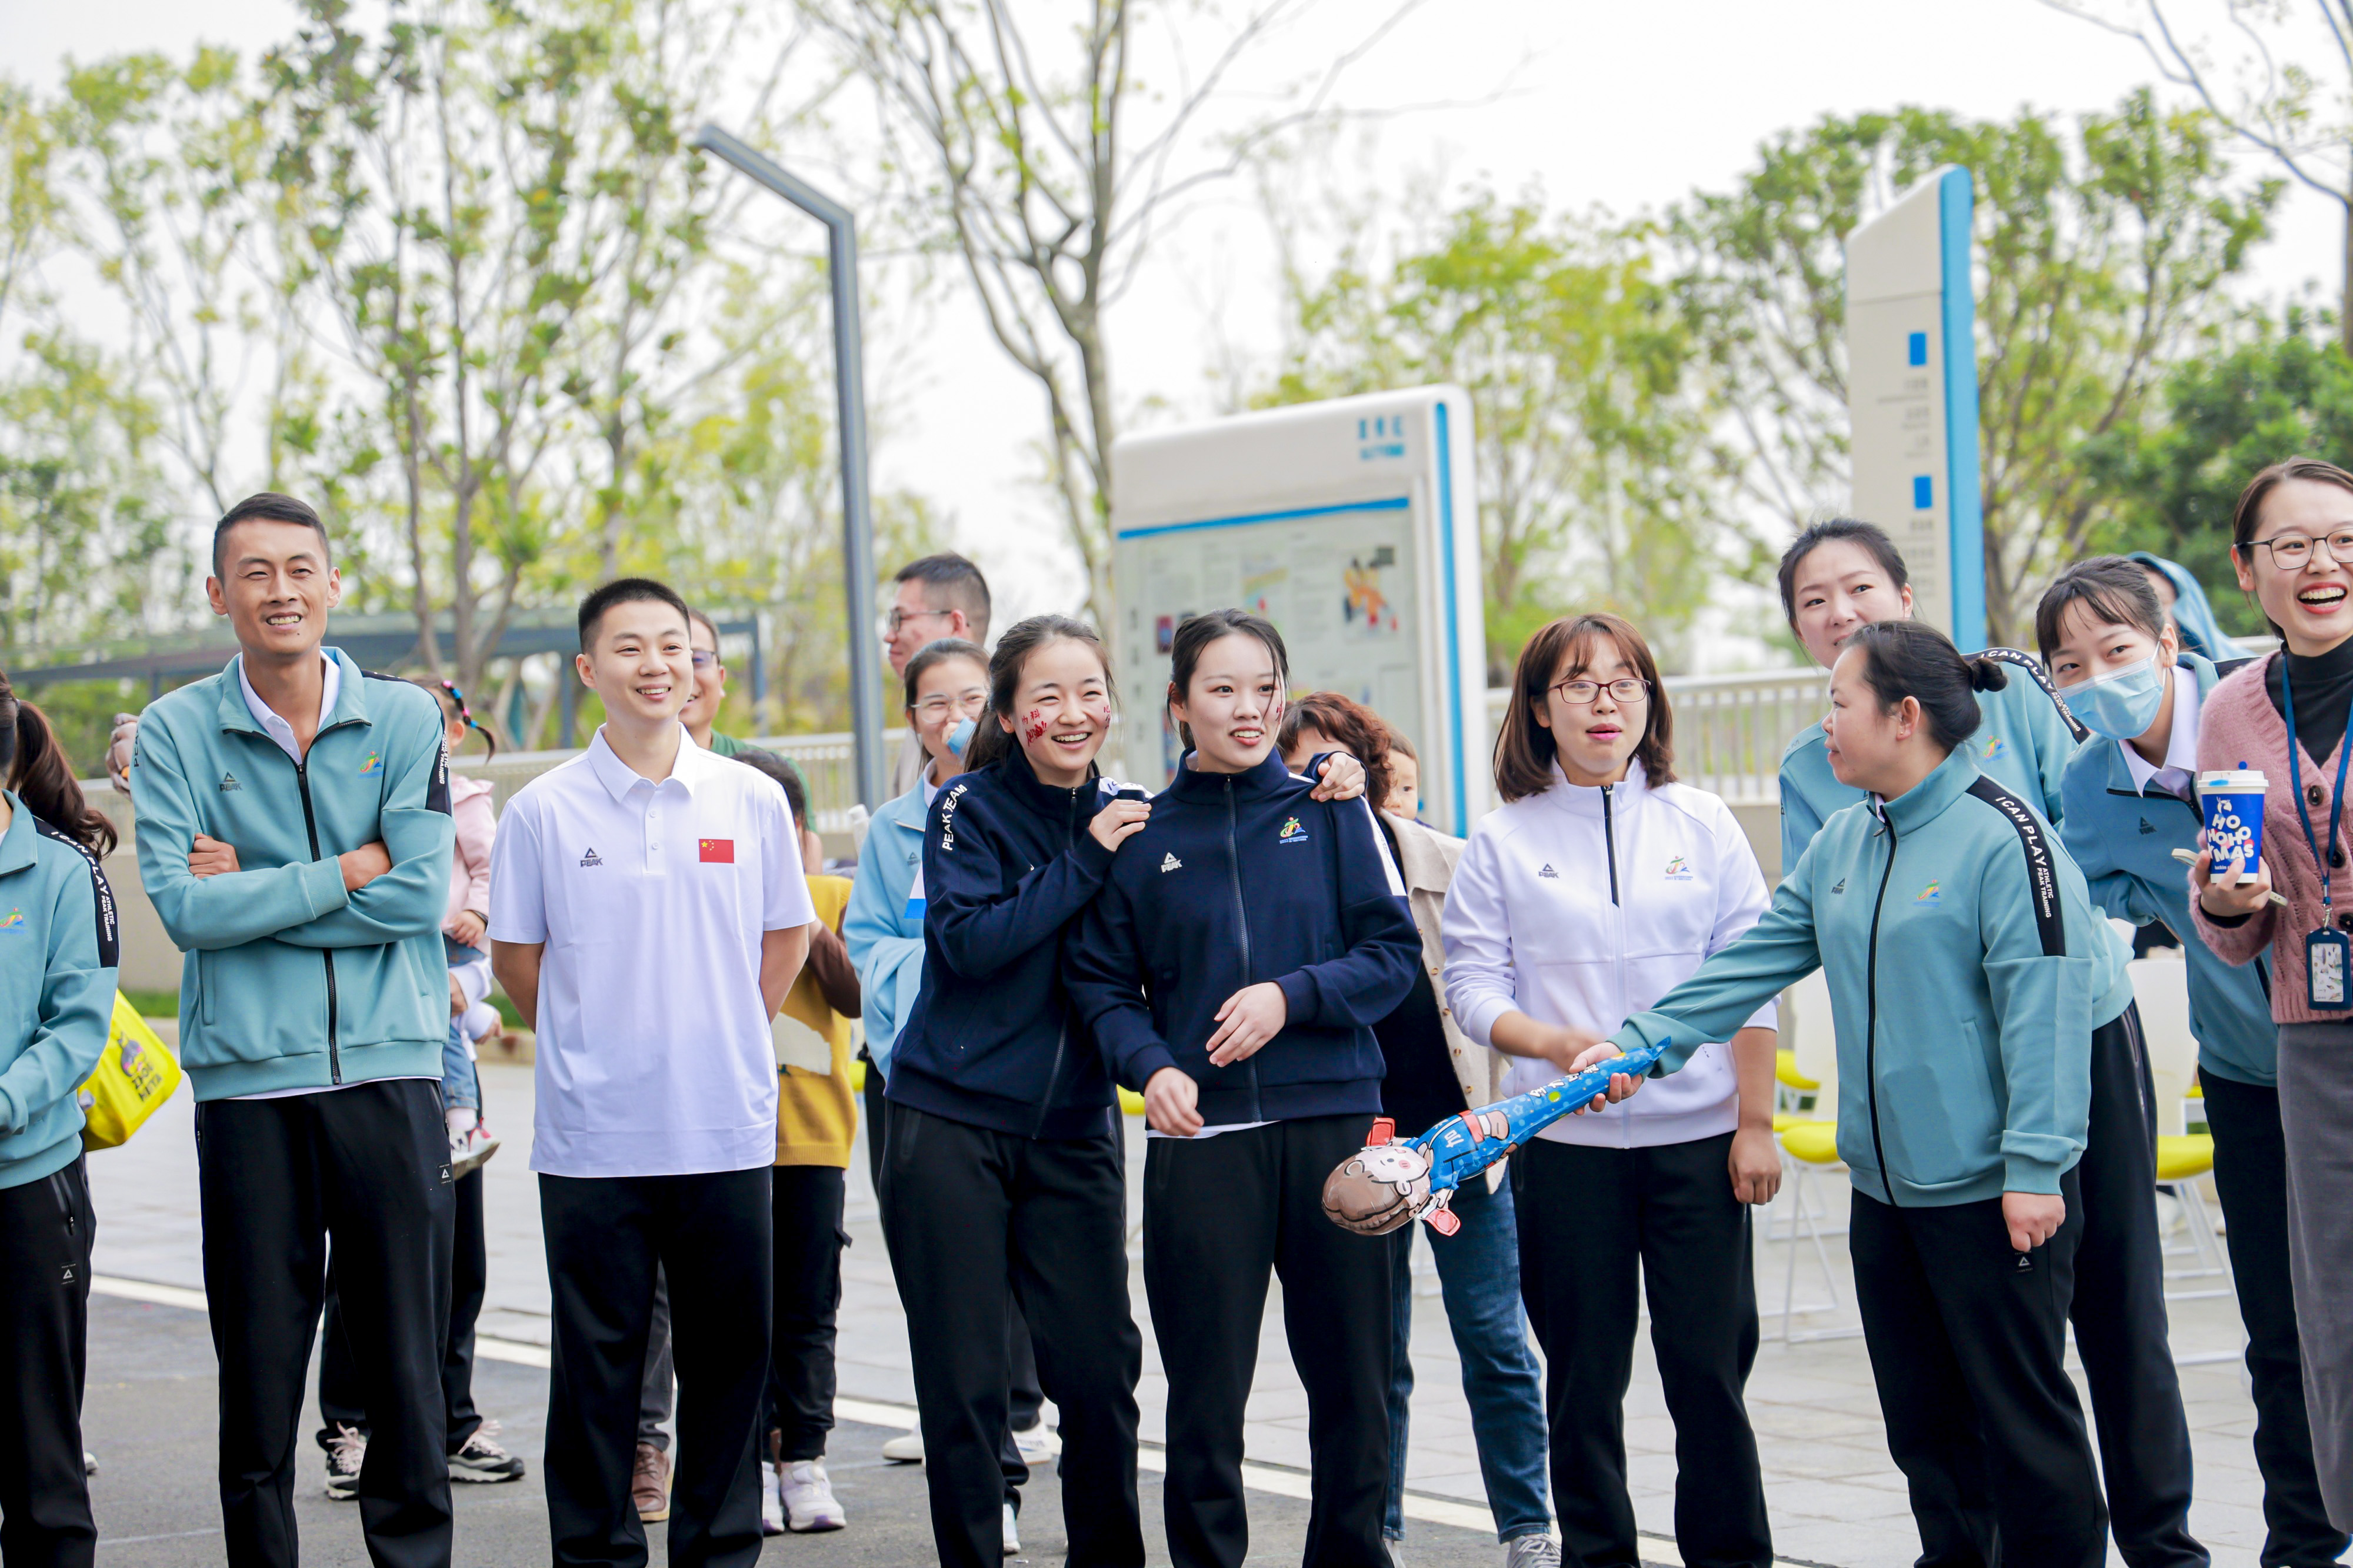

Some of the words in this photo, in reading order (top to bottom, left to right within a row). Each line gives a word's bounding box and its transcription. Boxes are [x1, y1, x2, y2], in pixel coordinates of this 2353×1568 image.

[1988, 650, 2022, 660] CAN
[2024, 659, 2055, 690] PLAY
[2061, 708, 2081, 732] TRAINING
[942, 784, 968, 812] TEAM
[942, 813, 954, 851] PEAK
[2001, 800, 2029, 822] CAN
[2022, 825, 2047, 866] PLAY
[2212, 813, 2241, 830] HO
[59, 835, 88, 853] CAN
[87, 856, 109, 895] PLAY
[580, 858, 604, 868] PEAK
[1161, 859, 1183, 873] PEAK
[2042, 868, 2054, 899] ATHLETIC
[105, 896, 115, 925] ATHLETIC
[2040, 887, 2052, 918] TRAINING
[104, 913, 113, 942] TRAINING
